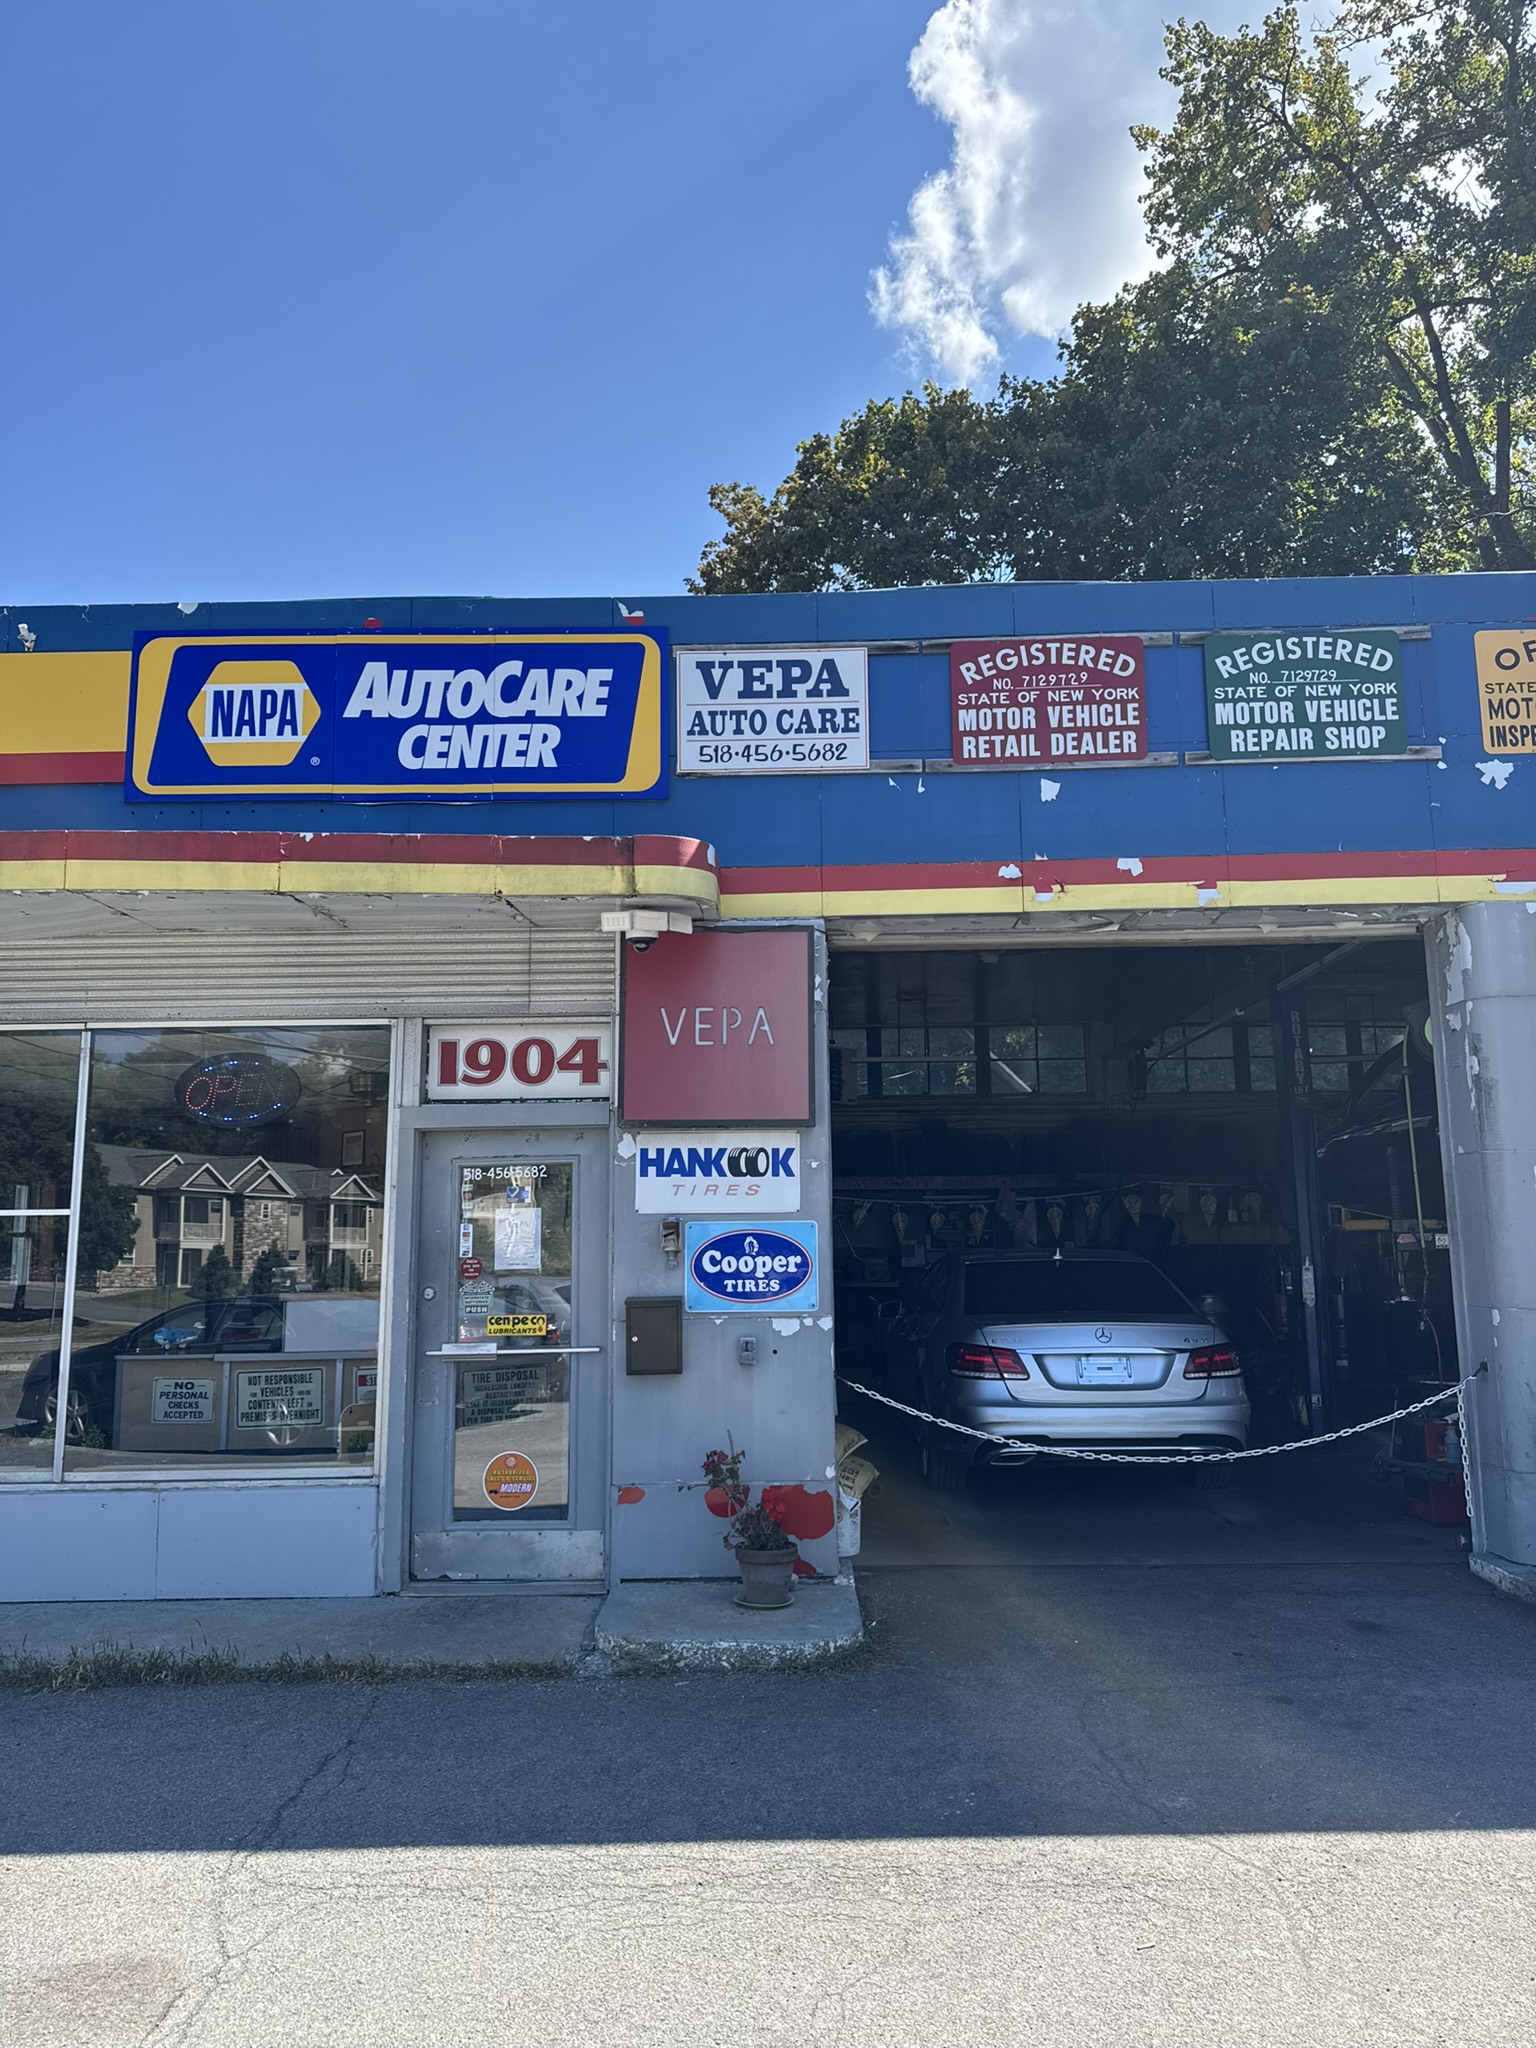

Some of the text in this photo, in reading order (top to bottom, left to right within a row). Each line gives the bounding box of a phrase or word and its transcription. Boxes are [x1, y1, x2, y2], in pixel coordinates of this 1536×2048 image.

[958, 642, 1137, 685] REGISTERED
[1214, 635, 1394, 679] REGISTERED
[695, 658, 849, 701] VEPA
[992, 671, 1090, 690] NO. 7129729
[1248, 669, 1337, 684] NO. 7129729
[957, 687, 1140, 706] STATE OF NEW YORK
[1214, 682, 1398, 700] STATE OF NEW YORK
[1484, 681, 1536, 695] STATE
[211, 688, 299, 738] NAPA
[957, 702, 1140, 732] MOTOR VEHICLE
[1214, 697, 1399, 726] MOTOR VEHICLE
[1487, 697, 1536, 720] MOT
[686, 706, 860, 736] AUTO CARE
[397, 723, 561, 770] CENTER
[962, 731, 1138, 759] RETAIL DEALER
[1230, 725, 1387, 753] REPAIR SHOP
[659, 1006, 775, 1047] VEPA
[1290, 1010, 1305, 1085] ROTARY
[437, 1036, 610, 1087] 1904
[185, 1072, 285, 1111] OPEN
[463, 1164, 548, 1181] 518-456-5682
[672, 1183, 761, 1197] TIRES
[701, 1249, 802, 1278] Cooper
[723, 1279, 780, 1293] TIRES
[488, 1327, 538, 1335] LUBRICANTS
[173, 1381, 195, 1391] NO
[247, 1373, 313, 1386] NOT RESPONSIBLE
[471, 1369, 540, 1384] TIRE DISPOSAL
[158, 1390, 210, 1401] PERSONAL
[260, 1386, 295, 1398] VEHICLES
[168, 1400, 200, 1410] CHECKS
[287, 1397, 305, 1409] LEFT
[162, 1410, 204, 1420] ACCEPTED
[499, 1483, 533, 1493] MODERN
